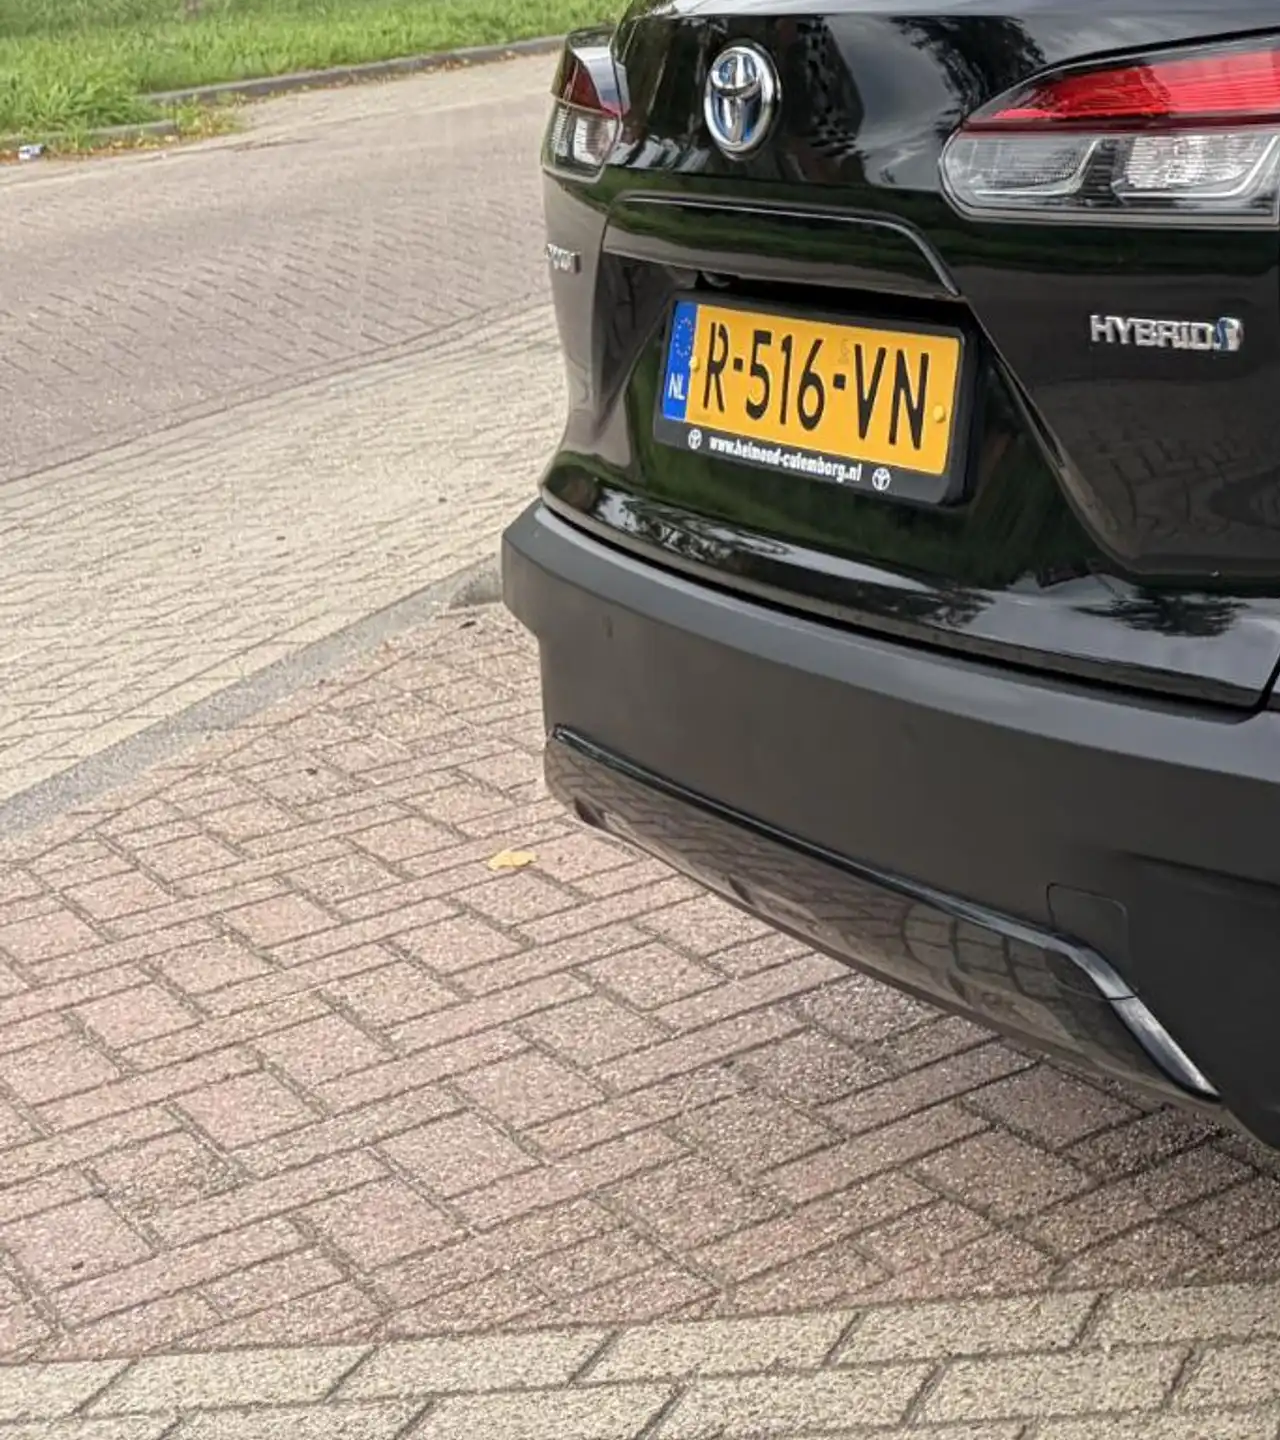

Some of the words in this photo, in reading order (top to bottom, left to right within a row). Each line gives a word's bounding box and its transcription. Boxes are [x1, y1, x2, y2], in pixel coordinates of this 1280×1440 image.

[1089, 314, 1214, 351] HYBRID
[667, 371, 687, 402] NL
[702, 320, 930, 451] R-516-VN
